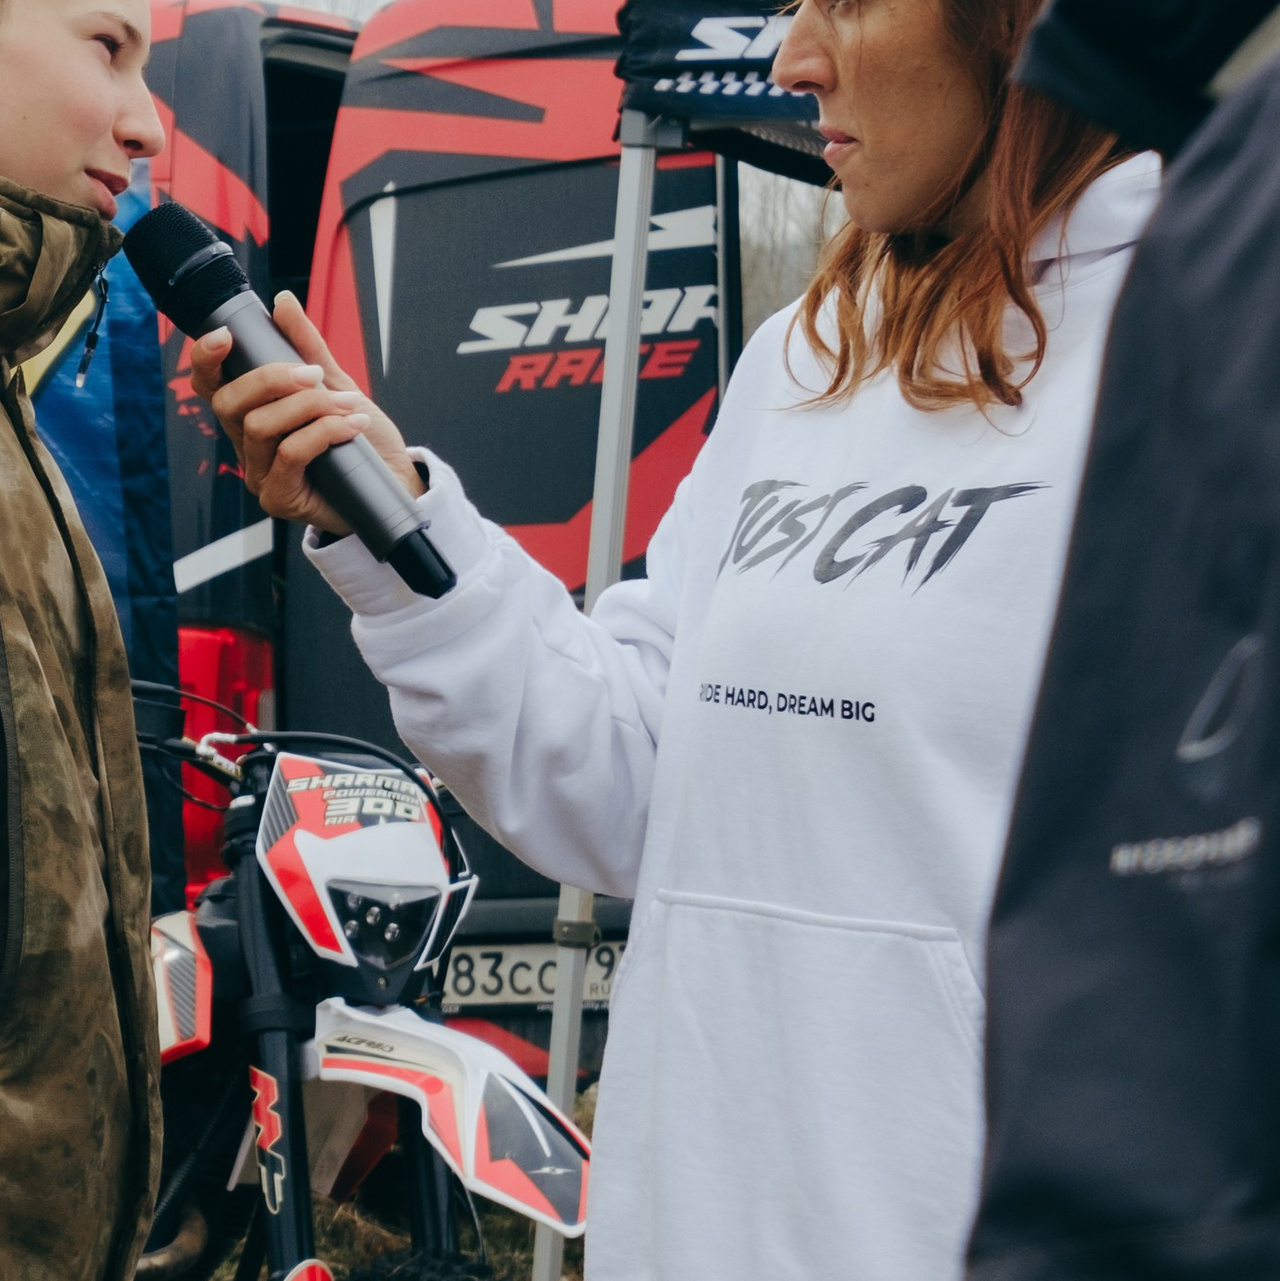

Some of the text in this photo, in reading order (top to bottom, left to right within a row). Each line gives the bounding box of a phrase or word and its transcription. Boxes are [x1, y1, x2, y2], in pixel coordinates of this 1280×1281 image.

[814, 481, 1054, 597] CAT
[724, 685, 773, 715] HARD,
[776, 692, 835, 718] DREAM
[841, 699, 876, 723] BIG
[324, 815, 357, 826] AIR
[325, 797, 420, 821] 300
